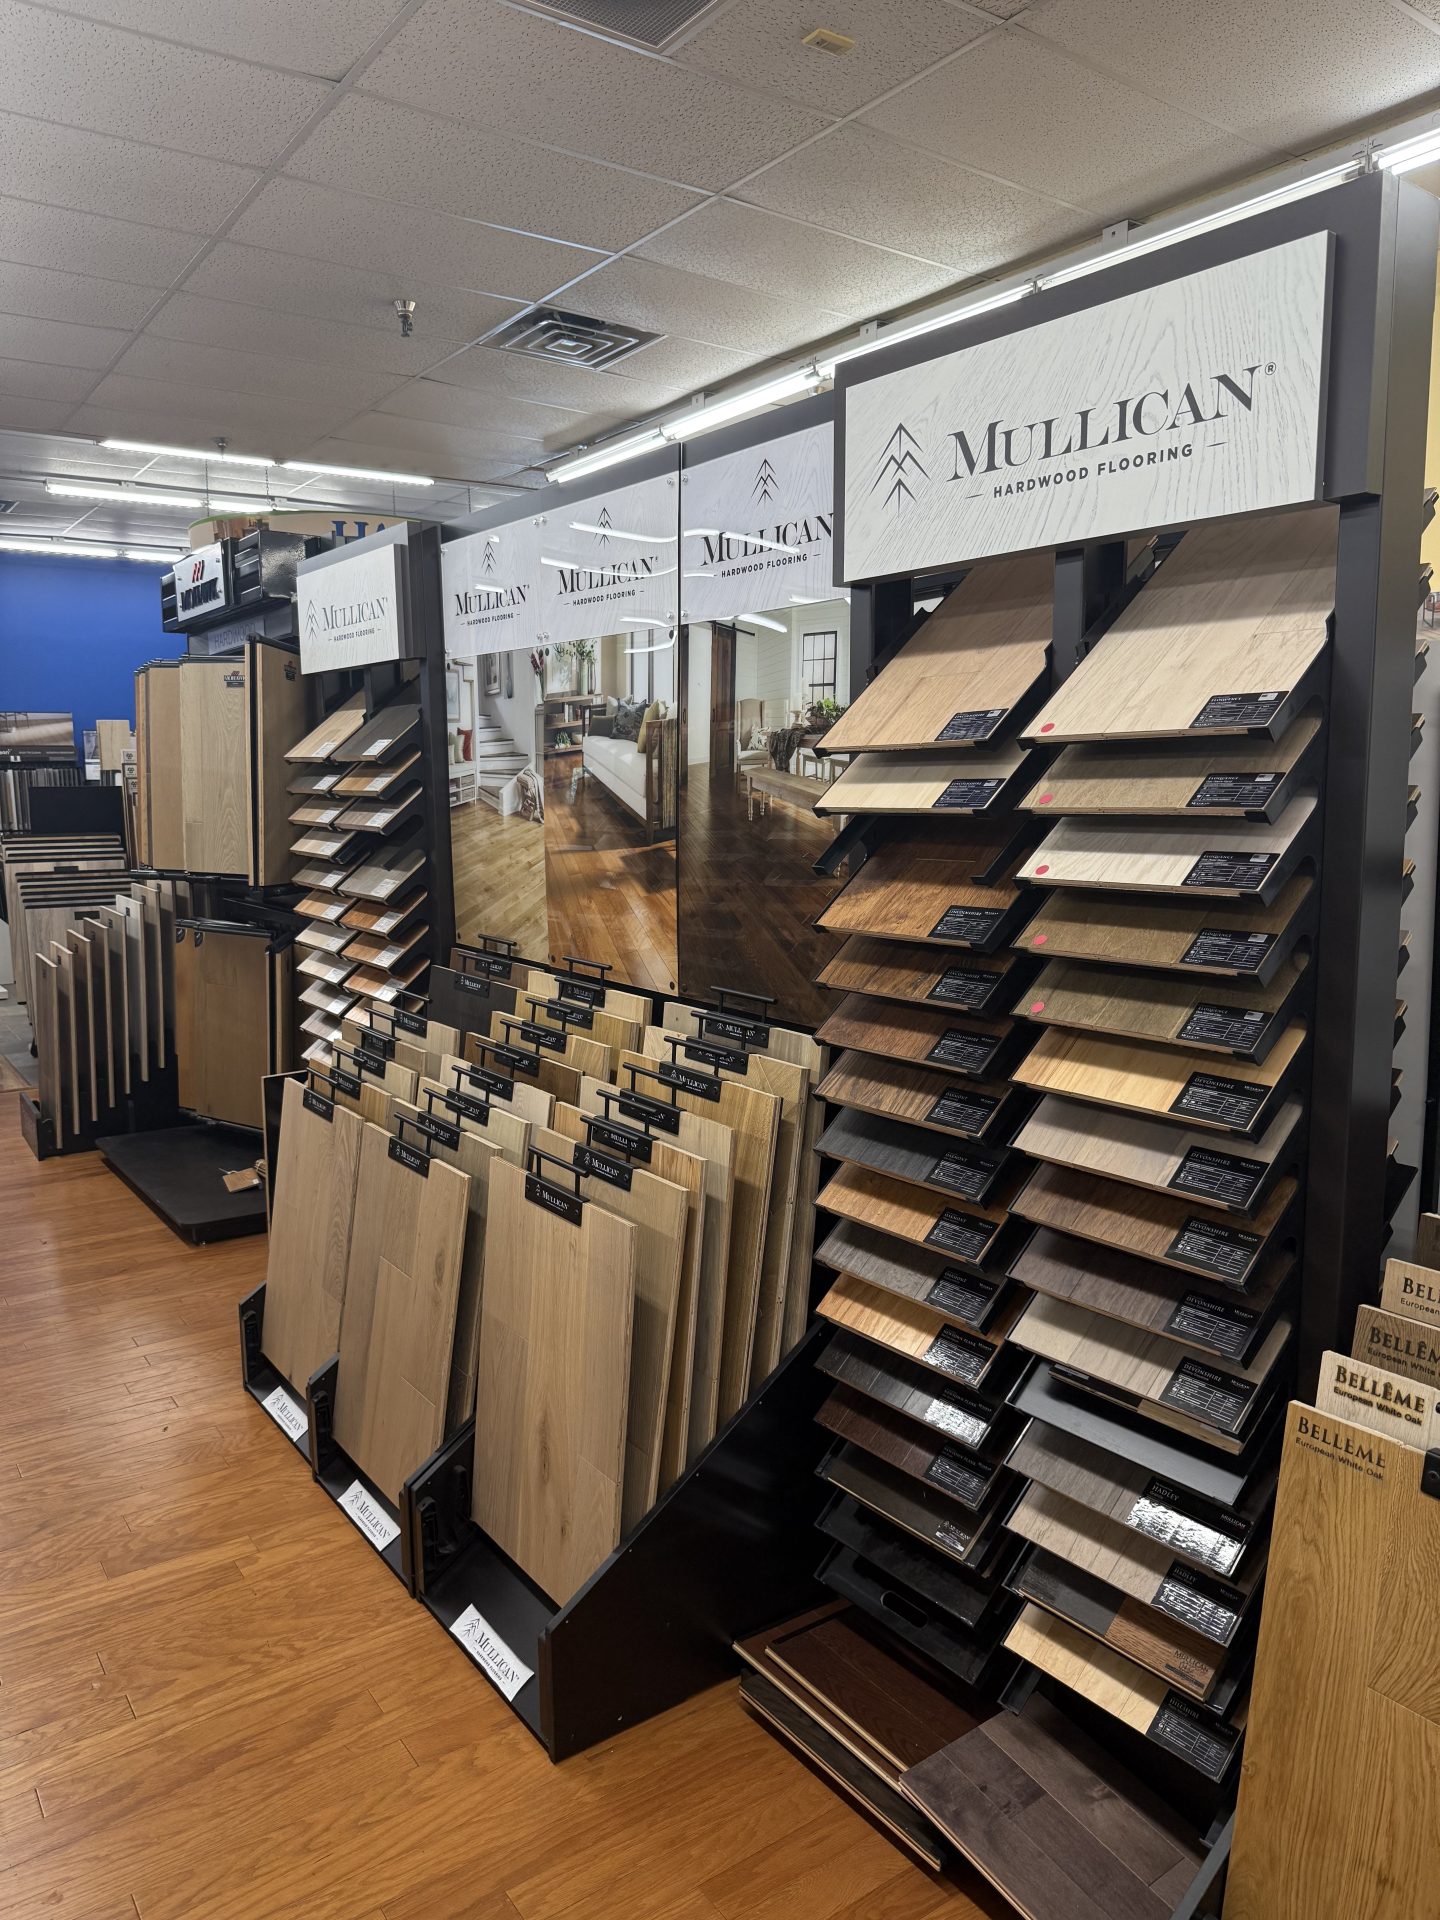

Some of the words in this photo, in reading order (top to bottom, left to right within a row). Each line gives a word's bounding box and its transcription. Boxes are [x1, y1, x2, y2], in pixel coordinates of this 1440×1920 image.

[993, 466, 1089, 499] HARDWOOD
[1098, 444, 1194, 476] FLOORING
[721, 561, 764, 578] HARDWOOD
[766, 554, 808, 569] FLOORING
[572, 595, 605, 606] HARDWOOD
[606, 590, 636, 601] FLOORING
[467, 615, 491, 626] HARDWOOD
[492, 612, 514, 623] FLOORING
[1367, 1347, 1407, 1366] European
[1410, 1360, 1436, 1376] White
[1333, 1386, 1374, 1407] European
[1376, 1401, 1403, 1419] White
[1404, 1412, 1423, 1426] Oak
[1295, 1436, 1335, 1460] European
[1338, 1453, 1364, 1473] White
[1366, 1466, 1385, 1481] Oak
[1152, 1485, 1179, 1501] HADLEY
